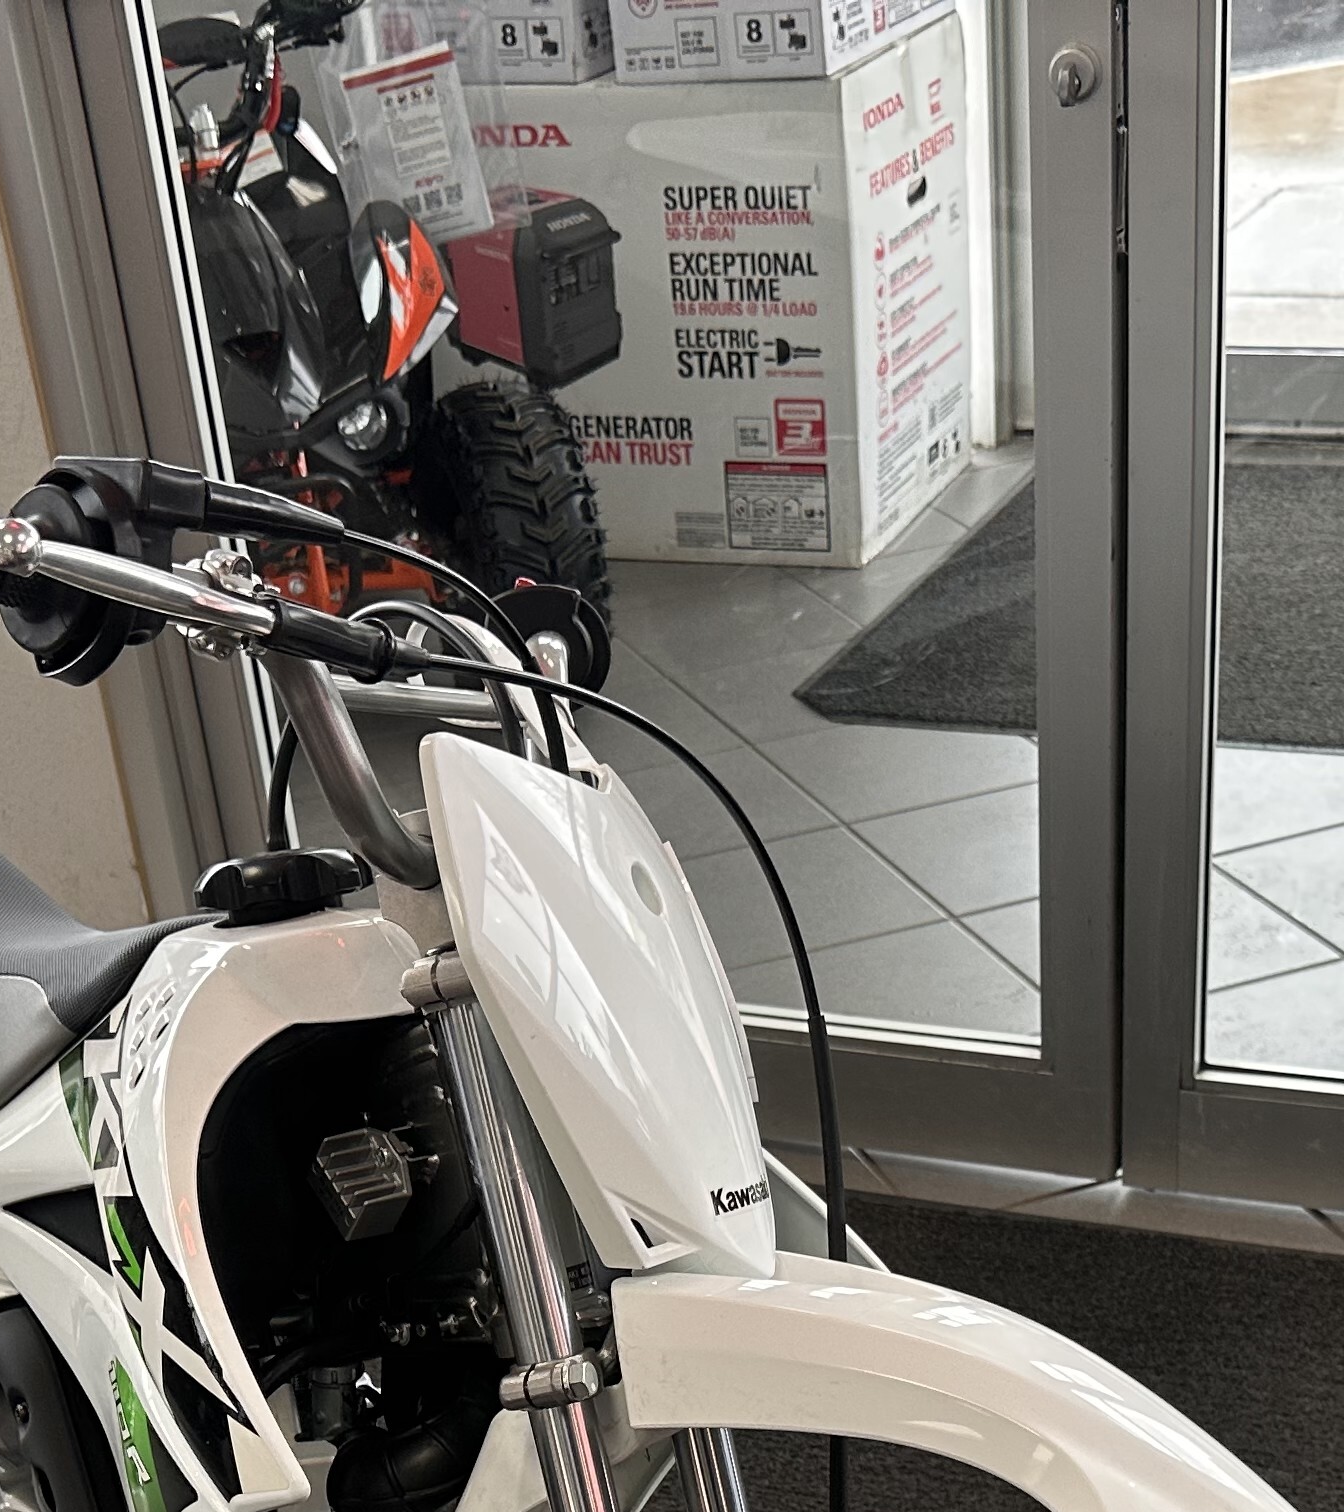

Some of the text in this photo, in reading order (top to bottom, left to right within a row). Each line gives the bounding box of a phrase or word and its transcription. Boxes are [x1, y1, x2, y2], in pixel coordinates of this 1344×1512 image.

[502, 23, 517, 47] 8
[747, 18, 762, 43] 8
[472, 124, 572, 148] NDA
[663, 185, 811, 211] SUPER QUIET
[665, 211, 691, 225] LIKE
[696, 211, 705, 225] A
[669, 252, 818, 276] EXCEPTIONAL
[671, 278, 781, 301] RUN TIME
[699, 302, 743, 316] HOURS
[747, 302, 757, 316] @
[763, 302, 780, 317] 1/4
[783, 302, 817, 316] LOAD
[675, 328, 759, 349] ELECTRIC
[677, 350, 759, 379] START
[568, 415, 693, 440] GENERATOR
[581, 441, 694, 465] CAN TRUST
